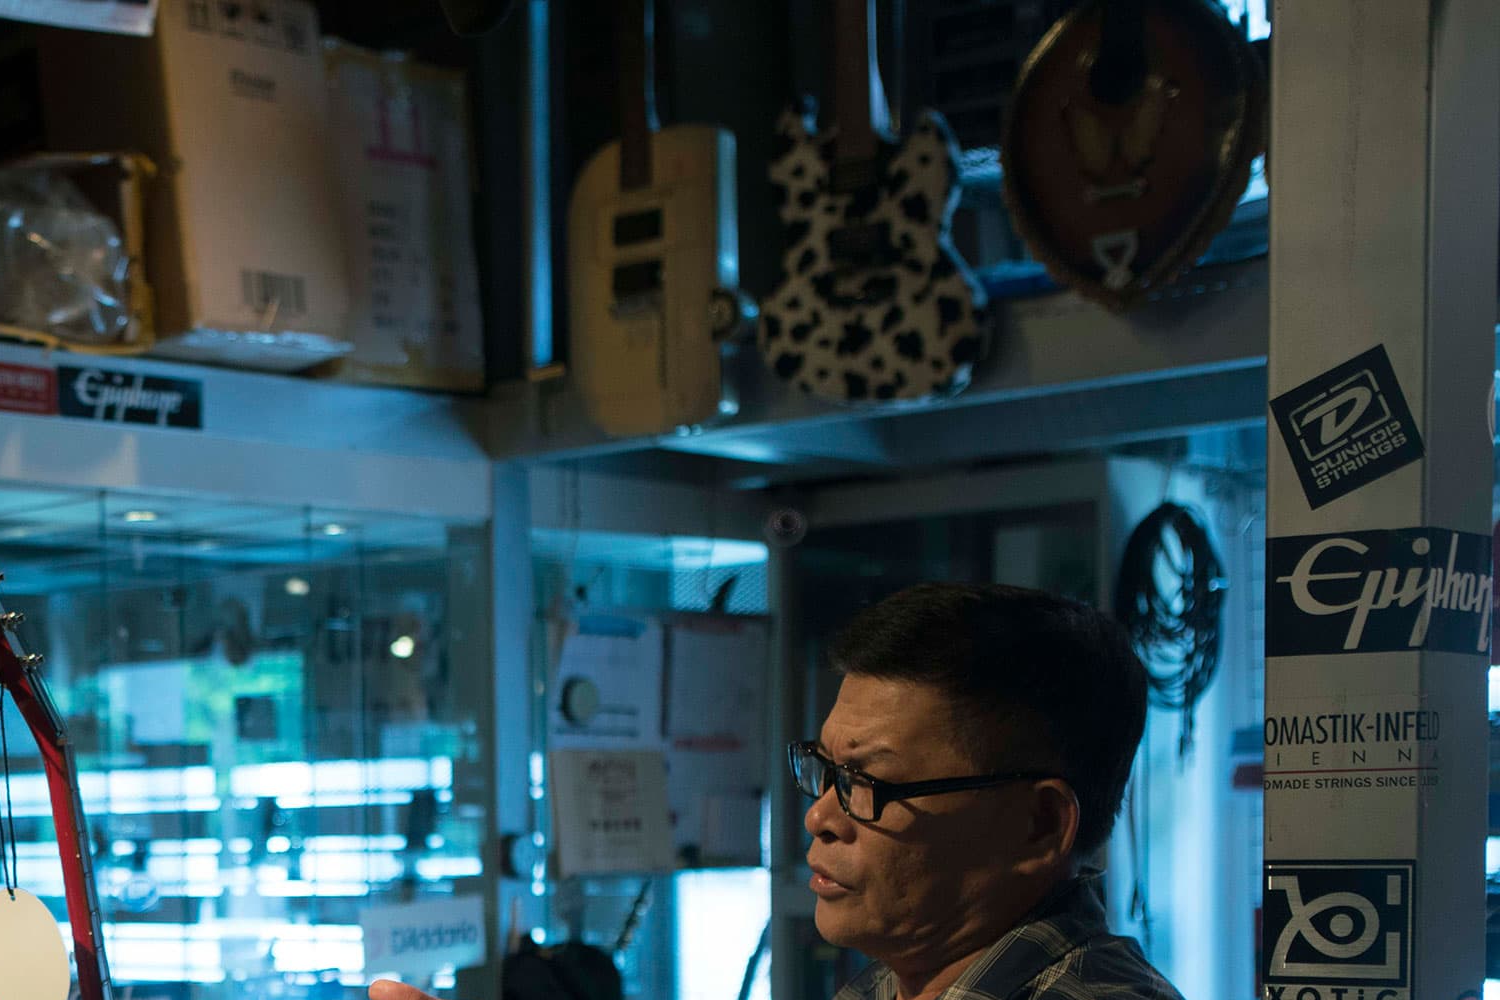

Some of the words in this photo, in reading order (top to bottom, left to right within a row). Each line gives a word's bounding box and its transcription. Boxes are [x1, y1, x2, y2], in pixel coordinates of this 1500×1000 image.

[1310, 420, 1402, 478] DUNLOP
[1315, 433, 1408, 489] STRINGS
[1315, 777, 1372, 789] STRINGS
[1376, 775, 1417, 787] SINCE
